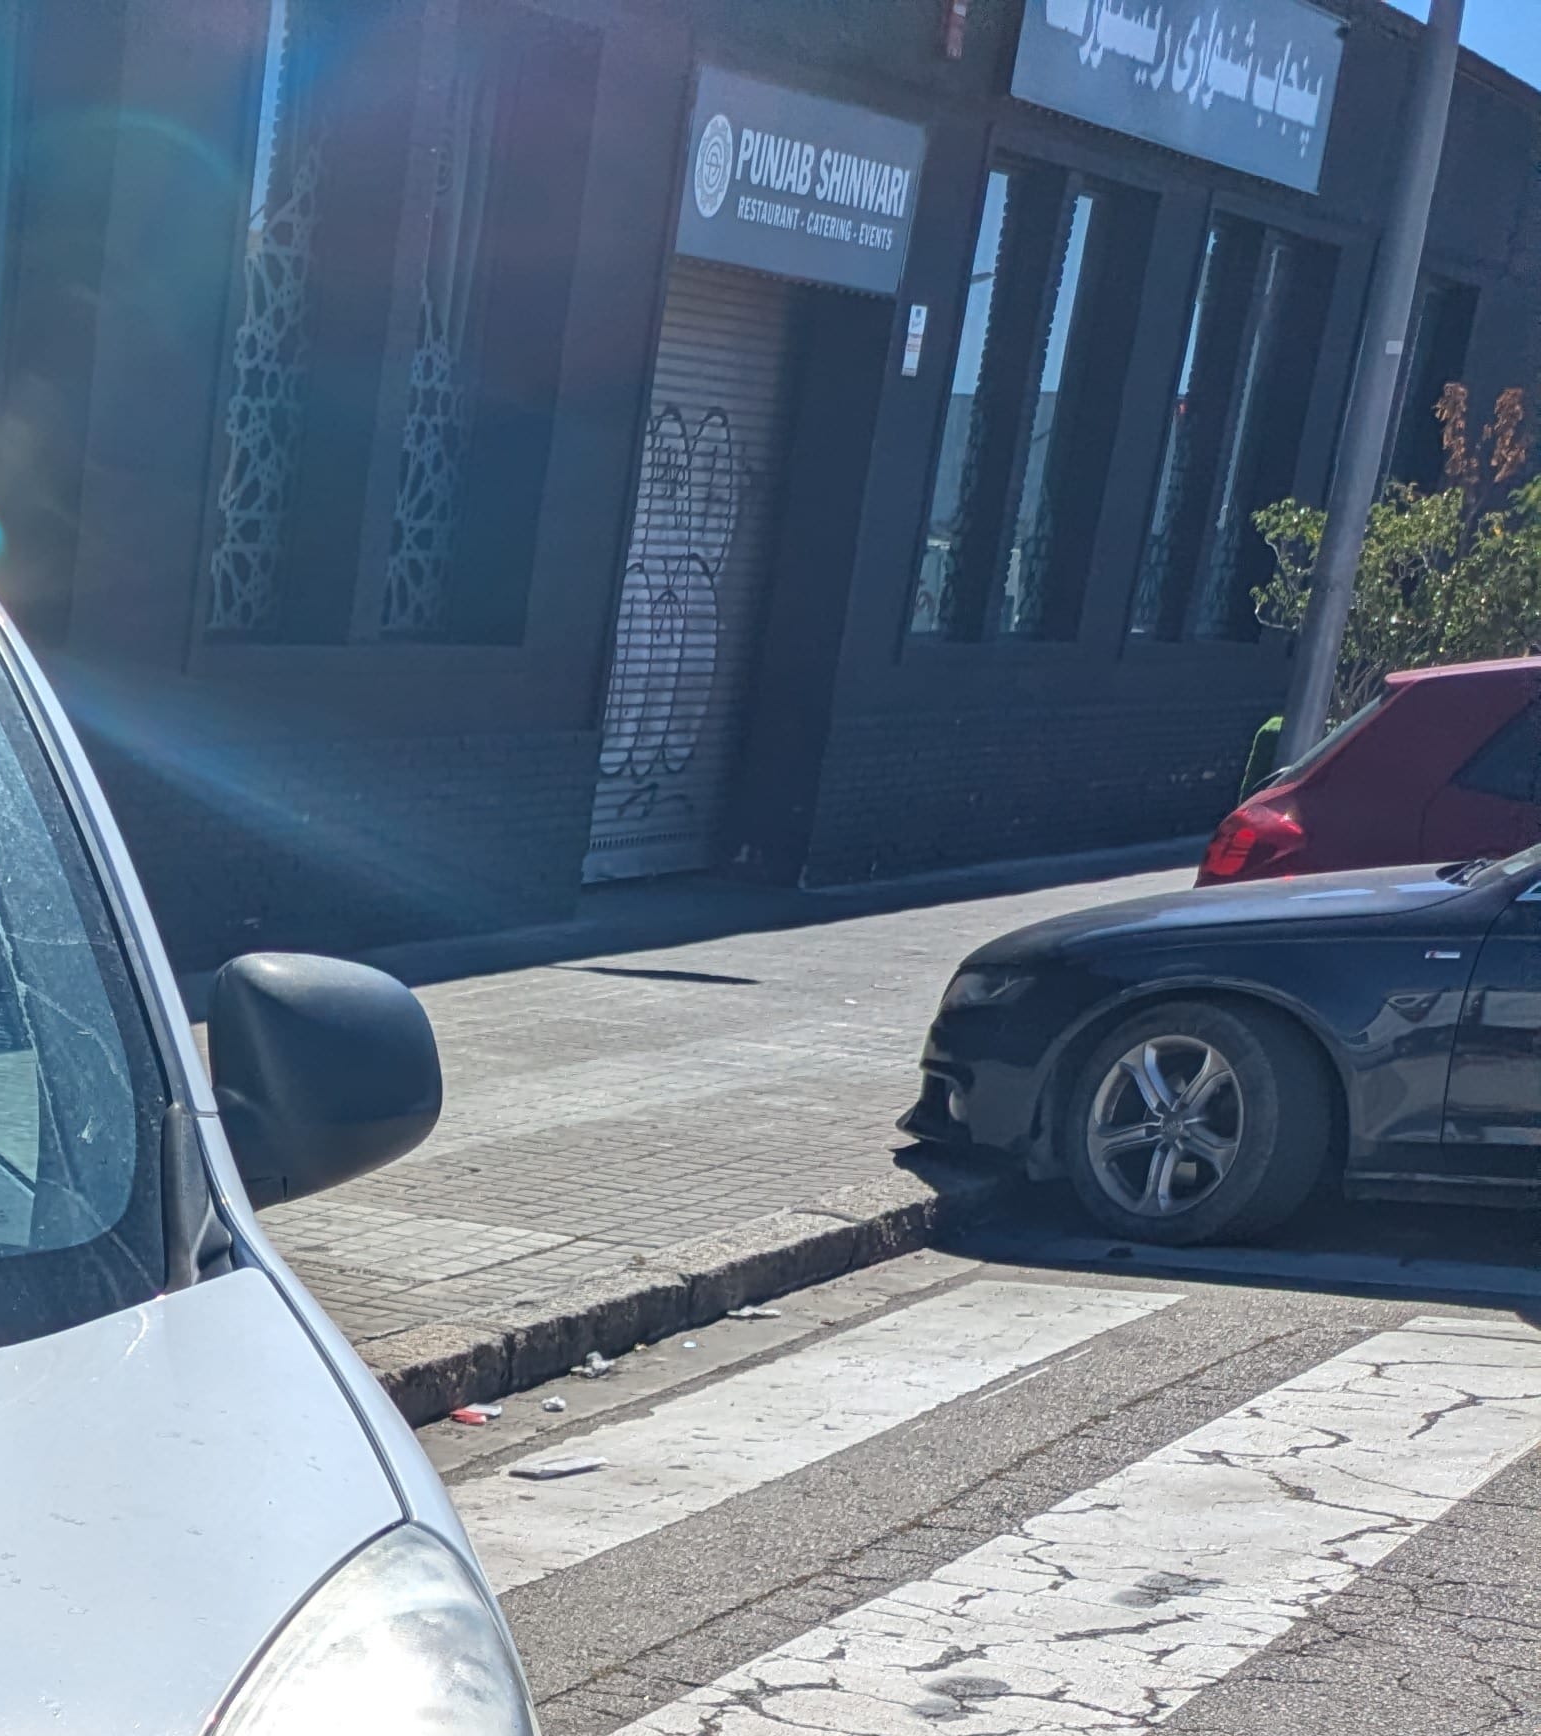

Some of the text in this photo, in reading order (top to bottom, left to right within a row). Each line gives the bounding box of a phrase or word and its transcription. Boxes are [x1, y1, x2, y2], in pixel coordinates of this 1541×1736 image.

[735, 127, 911, 218] PUNJAB SHINWARI
[737, 196, 893, 251] RESTAURANT CATERING EVENTS
